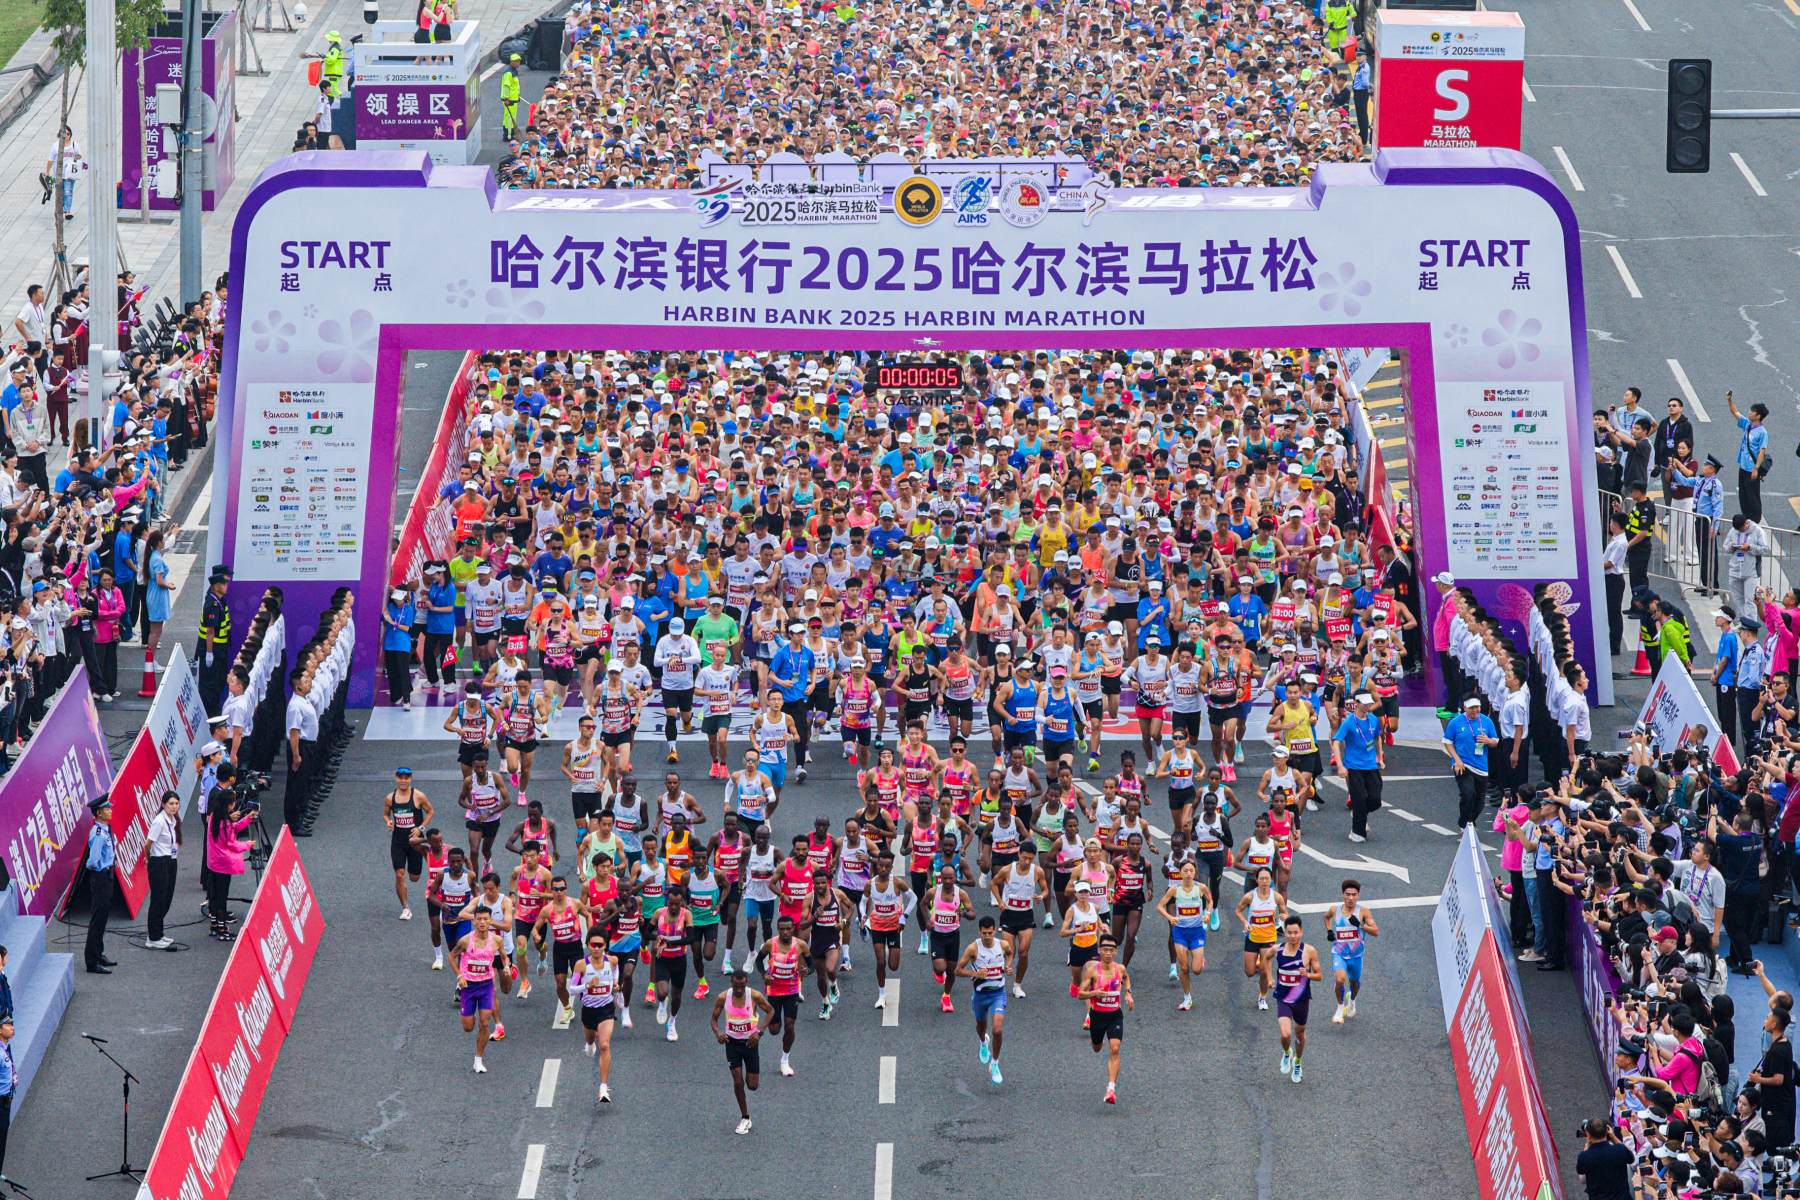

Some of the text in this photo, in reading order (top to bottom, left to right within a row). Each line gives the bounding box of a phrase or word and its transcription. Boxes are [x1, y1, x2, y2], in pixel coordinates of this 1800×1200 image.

[1452, 46, 1473, 56] 2025
[365, 92, 450, 116] 领操区
[1434, 69, 1470, 122] S
[1431, 125, 1472, 138] 马拉松
[1424, 140, 1477, 148] MARATHON
[1059, 191, 1089, 199] CHINA
[743, 200, 878, 222] 2025 哈尔滨马拉松
[958, 214, 987, 224] AIMS
[281, 241, 391, 269] START
[1420, 239, 1531, 268] START
[491, 234, 1318, 298] 哈尔滨银行2025哈尔滨马拉松
[664, 306, 1146, 327] HARBIN BANK 2025 HARBIN MARATHON
[880, 368, 958, 386] 00:00:05
[884, 395, 952, 406] GARMIN
[1275, 609, 1293, 618] 3:00
[1330, 624, 1350, 633] 3:00
[1484, 1084, 1528, 1200] 哈尔滨市人民
